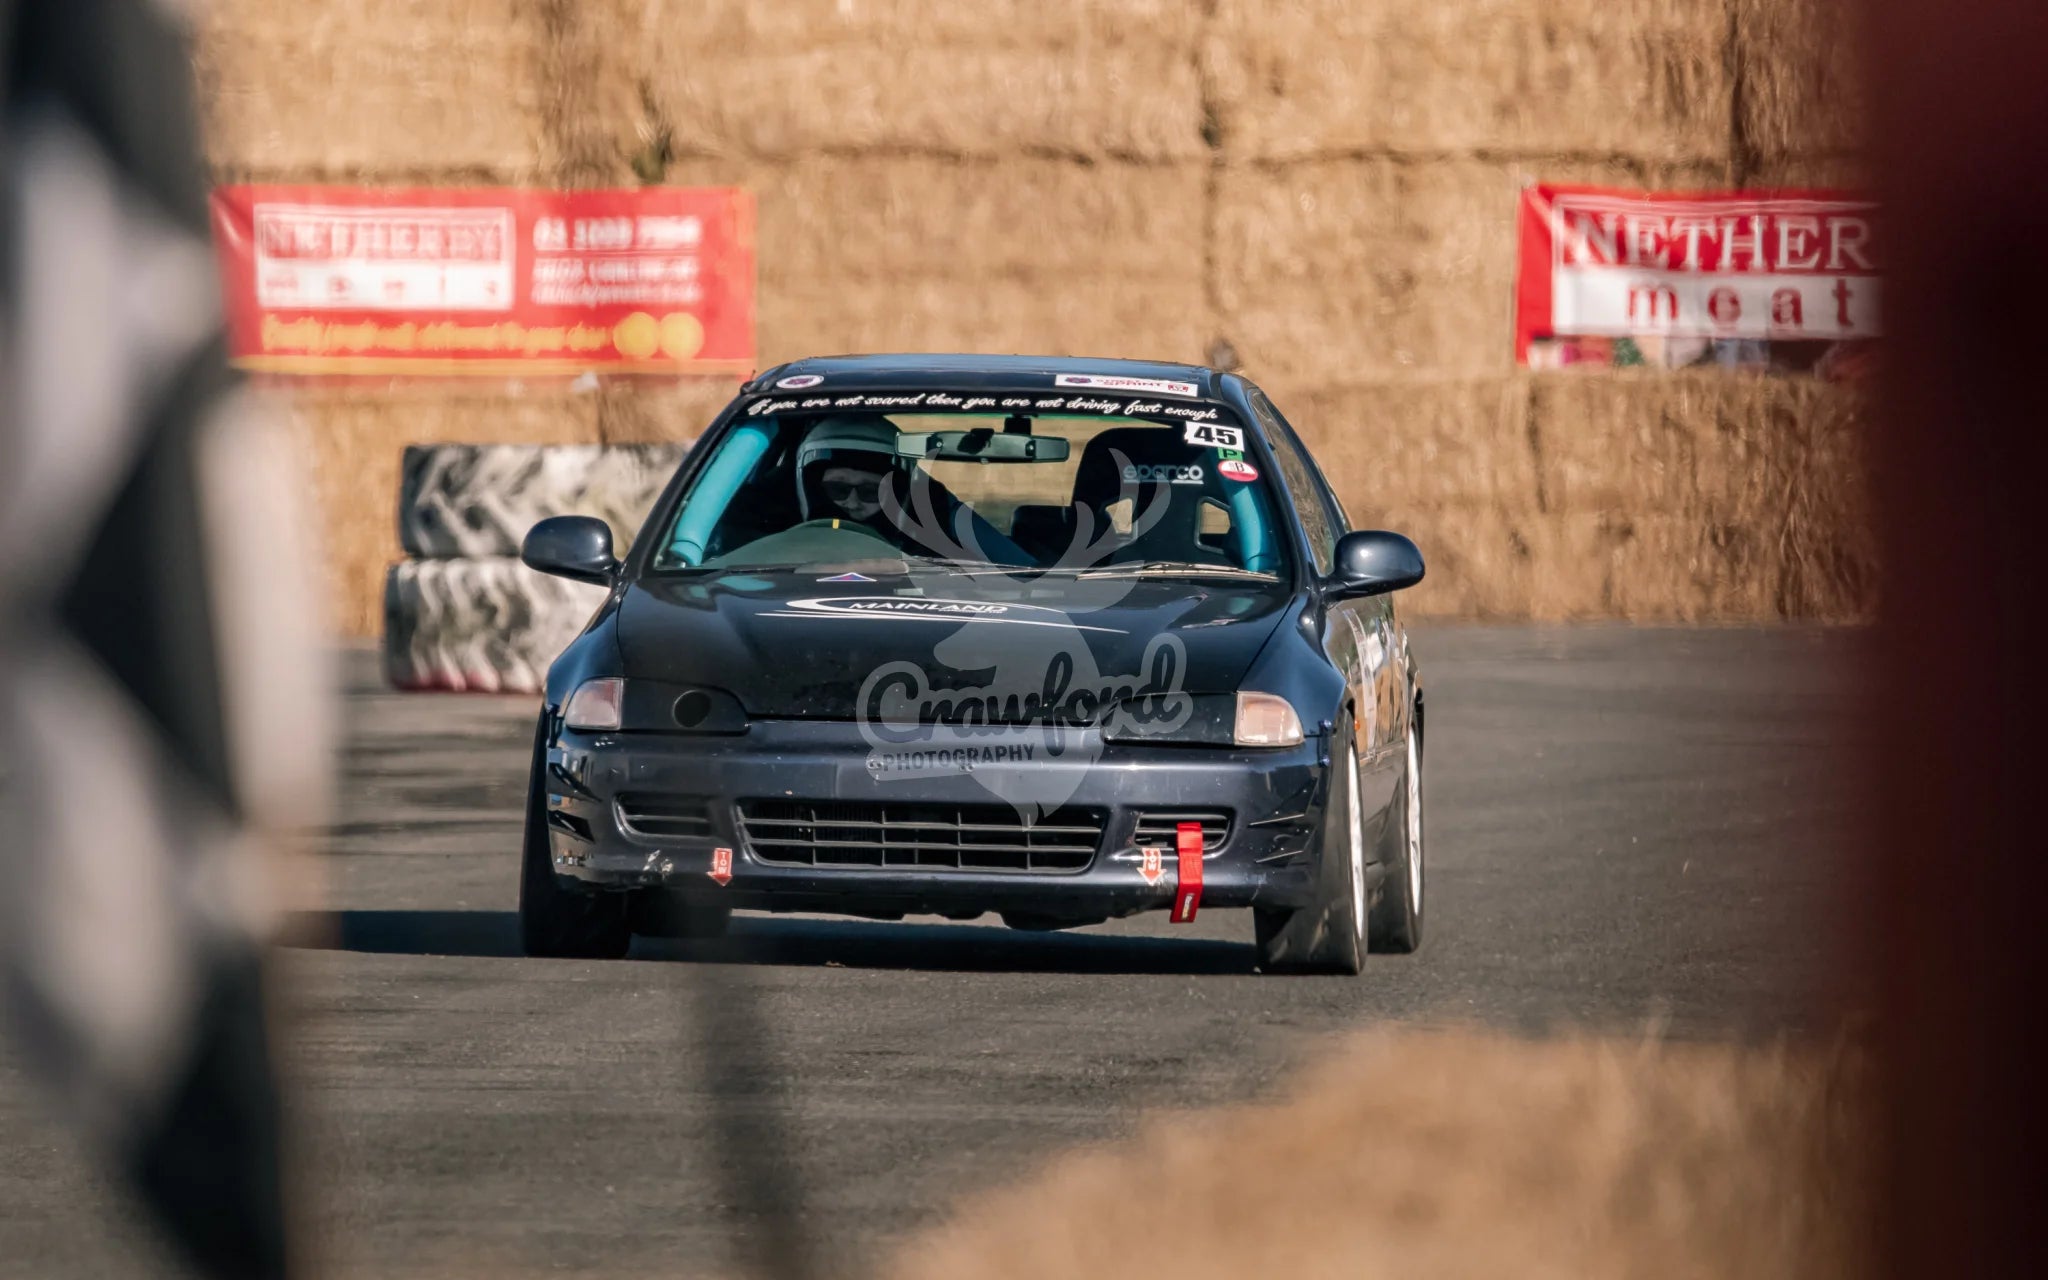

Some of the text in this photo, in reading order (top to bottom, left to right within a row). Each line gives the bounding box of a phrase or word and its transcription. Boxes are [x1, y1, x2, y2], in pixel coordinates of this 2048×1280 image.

[762, 400, 798, 415] you
[801, 398, 831, 407] are
[834, 395, 864, 407] not
[864, 393, 926, 406] scared
[926, 393, 963, 406] then
[961, 398, 996, 410] you
[1001, 398, 1031, 407] are
[1035, 397, 1065, 408] not
[1066, 396, 1121, 414] driving
[1124, 400, 1162, 415] fast
[1164, 407, 1218, 421] enough
[1193, 426, 1237, 446] 45
[1123, 464, 1204, 481] sparco
[849, 602, 1008, 613] MAINLAND
[718, 851, 728, 875] TOW
